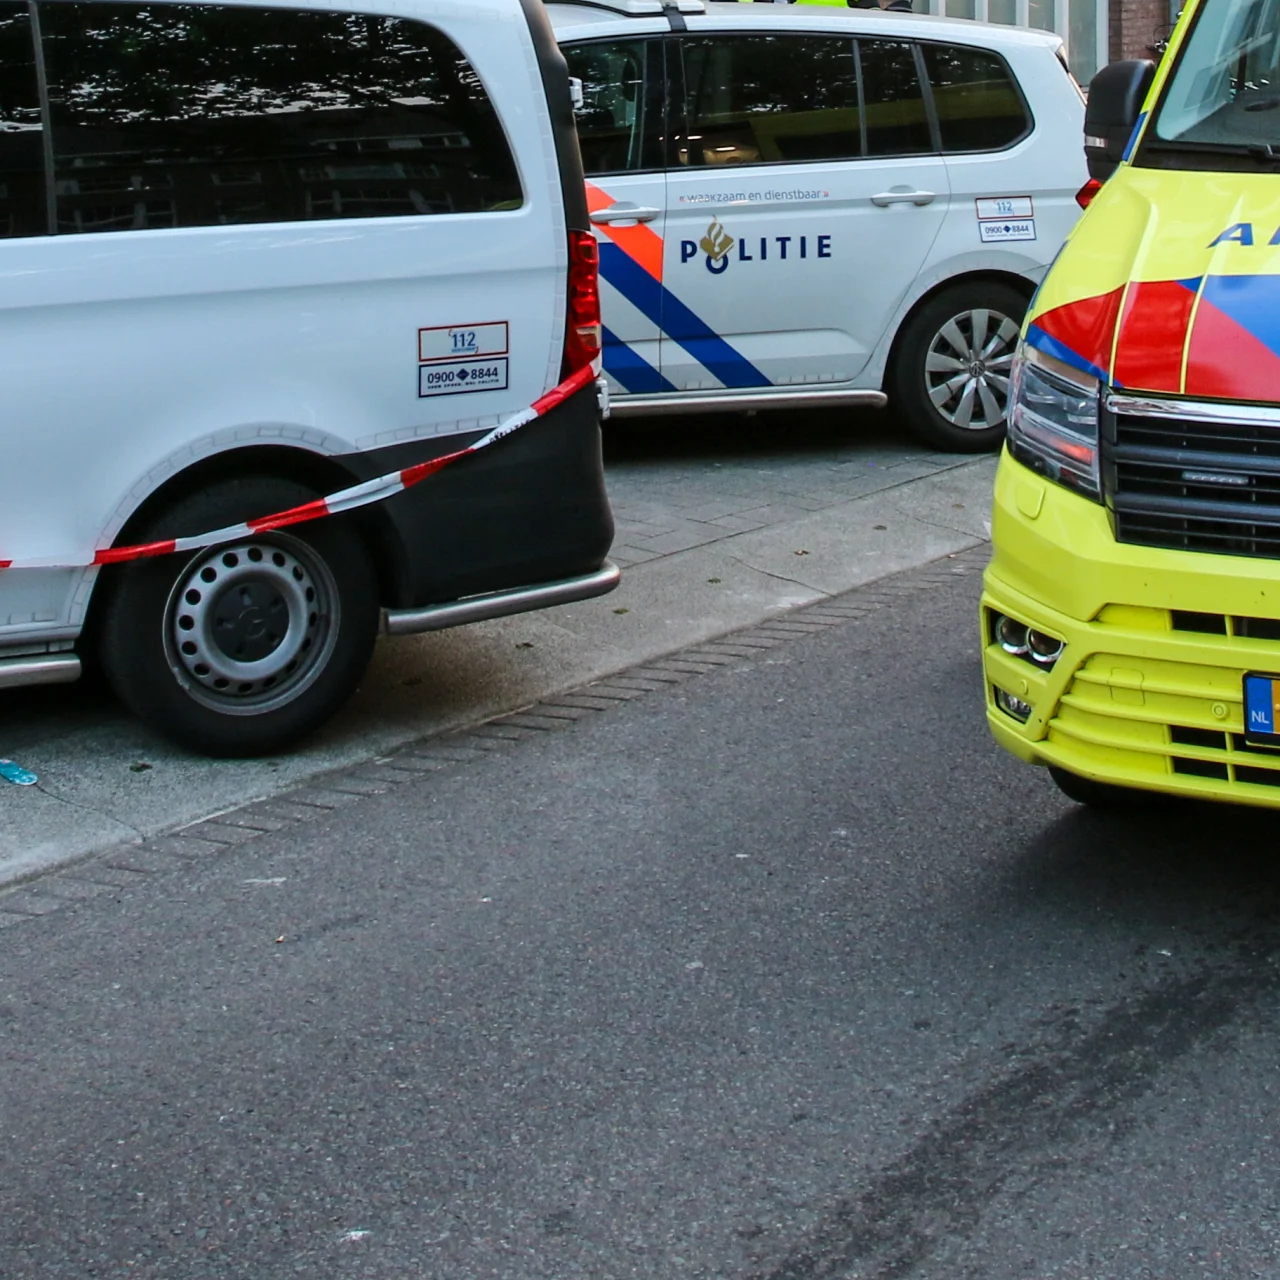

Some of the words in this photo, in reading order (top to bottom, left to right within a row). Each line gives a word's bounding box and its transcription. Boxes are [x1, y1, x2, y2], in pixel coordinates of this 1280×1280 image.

[688, 193, 746, 203] waakzaam
[749, 192, 762, 201] en
[765, 189, 821, 201] dienstbaar
[681, 235, 832, 275] POLITIE
[427, 371, 455, 384] 0900
[471, 367, 498, 380] 8844
[1251, 710, 1270, 724] NL
